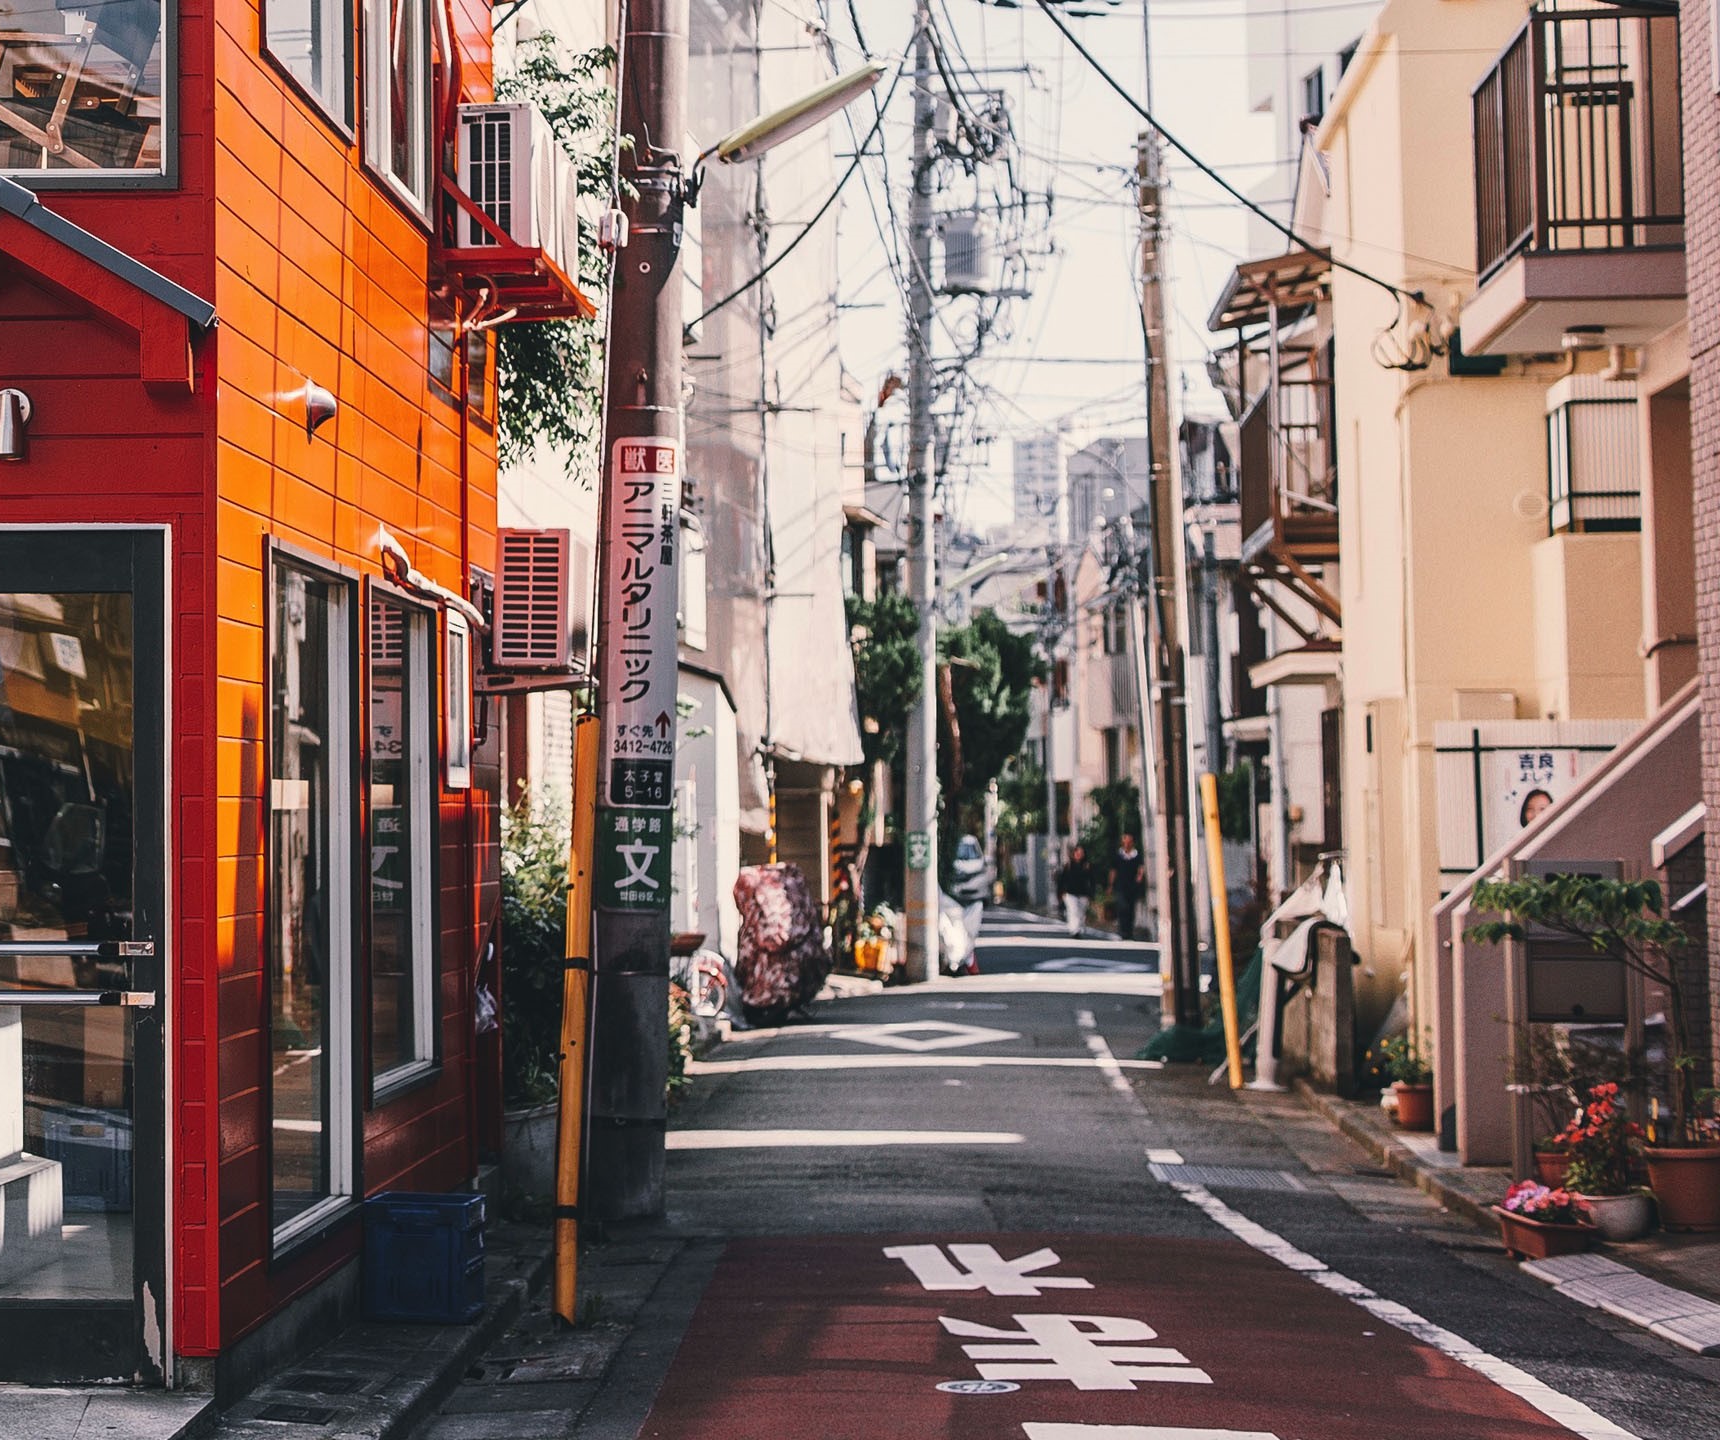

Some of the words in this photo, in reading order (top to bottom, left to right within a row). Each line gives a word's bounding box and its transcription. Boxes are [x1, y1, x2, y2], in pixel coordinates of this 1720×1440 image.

[624, 447, 674, 473] 獣医
[659, 483, 674, 566] 三軒茶屋
[614, 816, 662, 833] 通学路
[614, 837, 660, 889] 文
